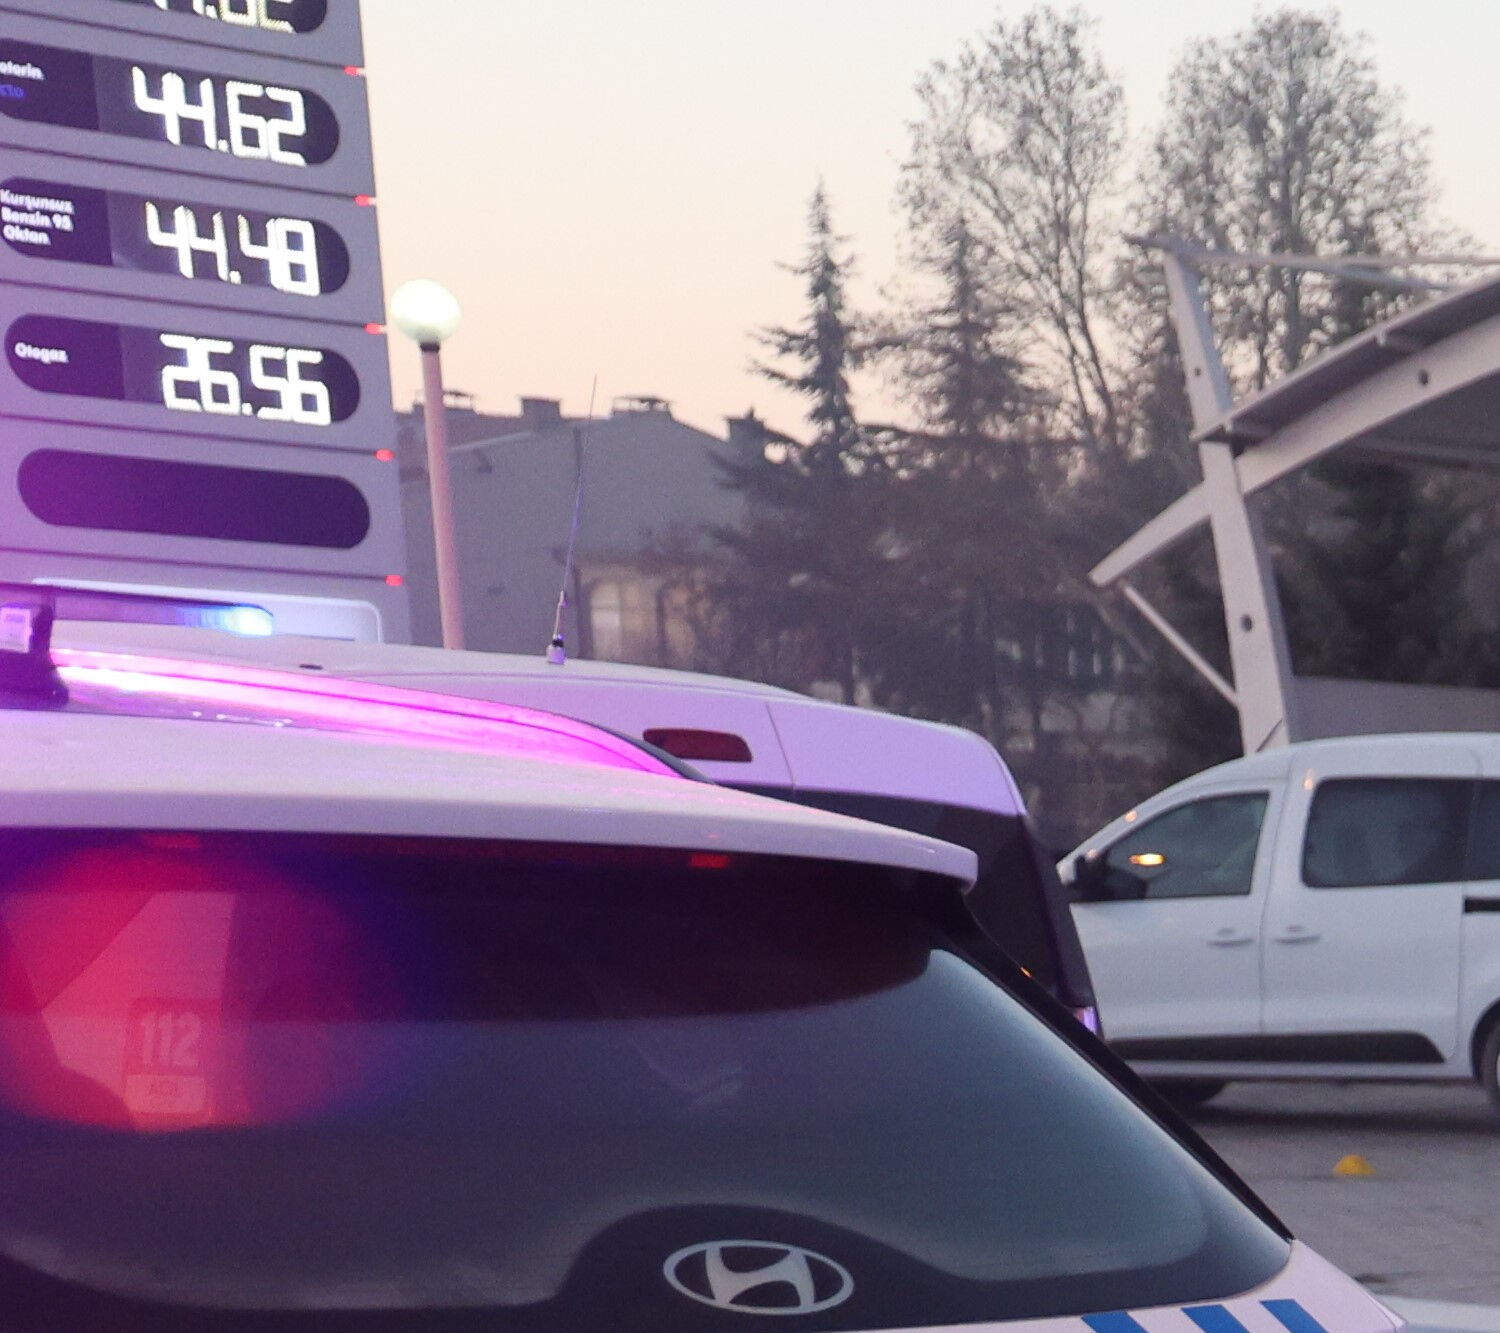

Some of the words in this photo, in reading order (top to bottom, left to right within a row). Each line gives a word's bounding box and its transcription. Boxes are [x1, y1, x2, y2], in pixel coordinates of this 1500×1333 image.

[0, 60, 44, 80] otorin
[132, 66, 306, 167] 44.62
[1, 205, 51, 228] Benzin
[3, 223, 51, 245] Oktan
[146, 201, 320, 296] 44.48
[14, 341, 69, 364] Otogaz
[160, 333, 332, 426] 26.56
[140, 1010, 201, 1068] 112
